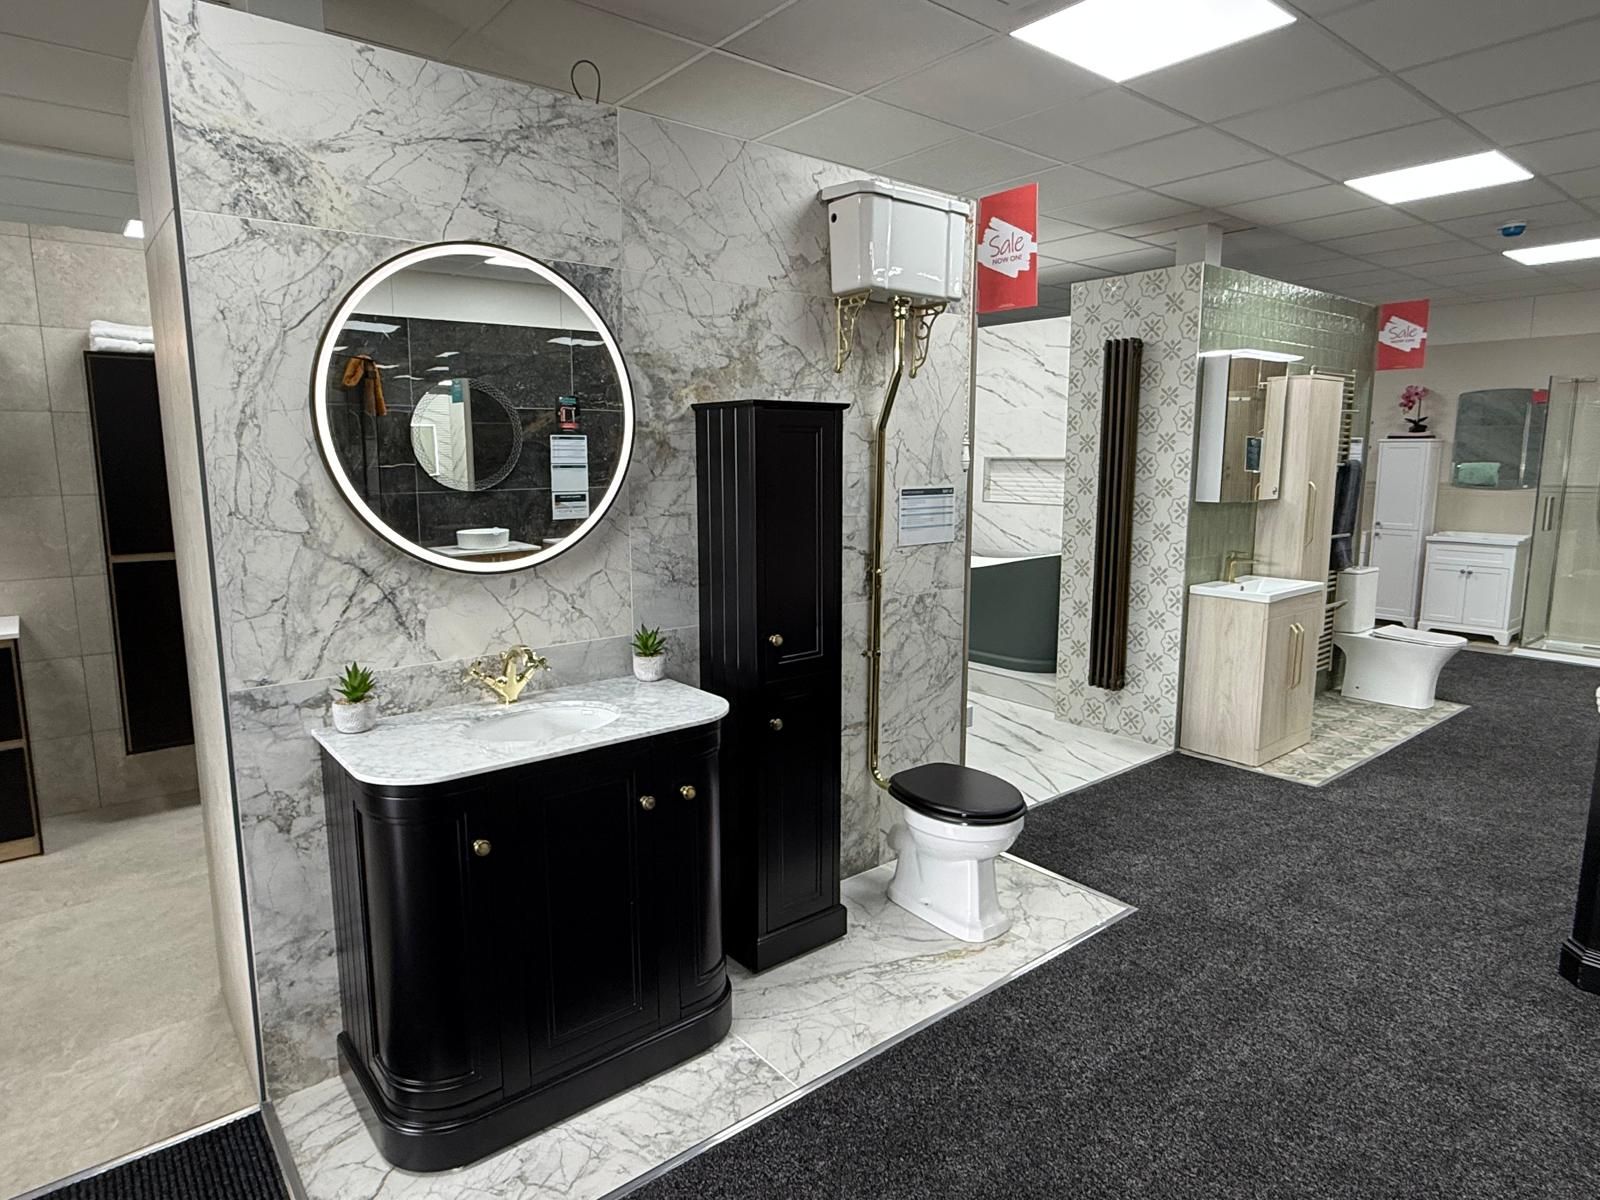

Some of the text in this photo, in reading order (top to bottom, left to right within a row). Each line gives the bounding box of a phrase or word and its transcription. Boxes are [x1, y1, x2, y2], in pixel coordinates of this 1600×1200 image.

[989, 232, 1024, 257] Sale
[992, 257, 1008, 265] NOW
[1388, 325, 1417, 340] Sale
